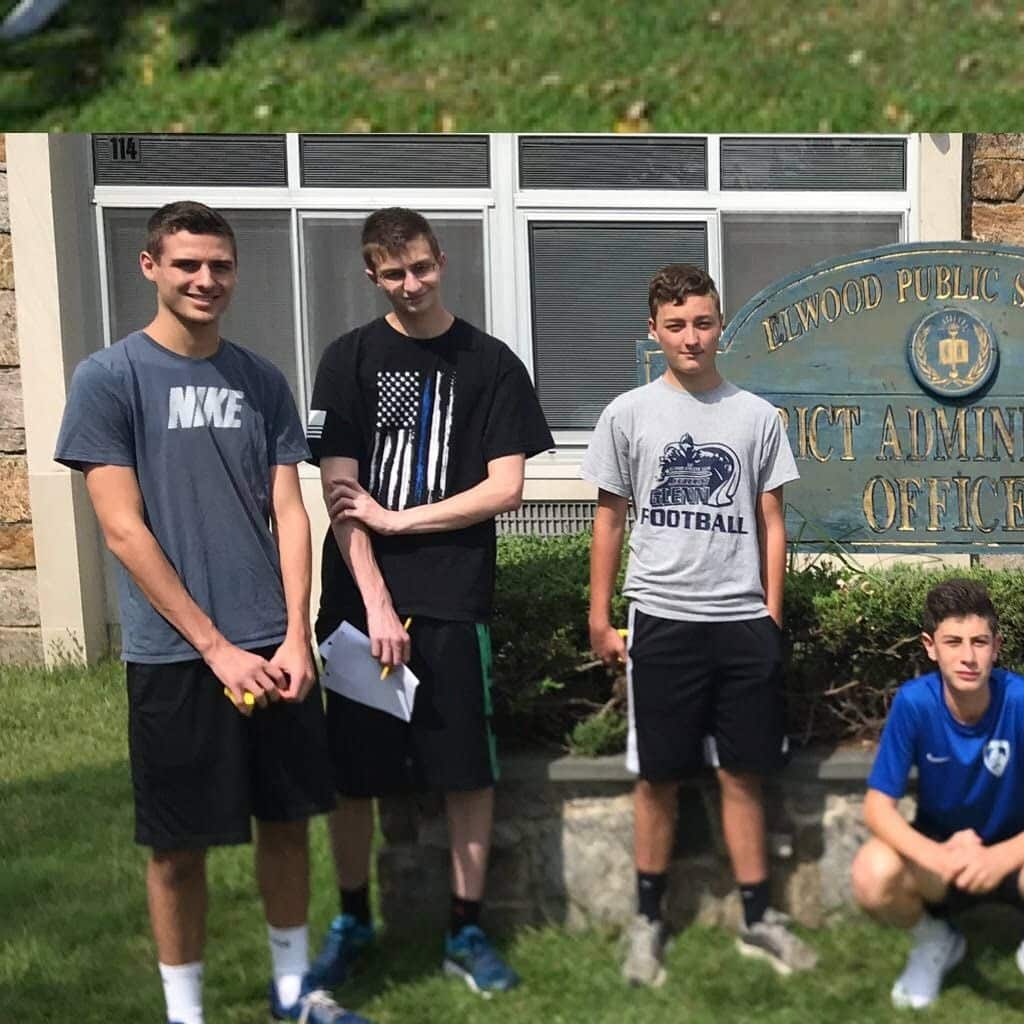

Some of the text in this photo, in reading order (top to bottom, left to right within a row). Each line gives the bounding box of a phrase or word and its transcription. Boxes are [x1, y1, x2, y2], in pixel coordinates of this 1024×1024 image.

[111, 137, 137, 160] 114
[761, 273, 883, 353] ELWOOD
[896, 265, 999, 304] PUBLIC
[167, 385, 245, 429] NIKE
[650, 486, 711, 507] GLENN
[640, 507, 749, 535] FOOTBALL
